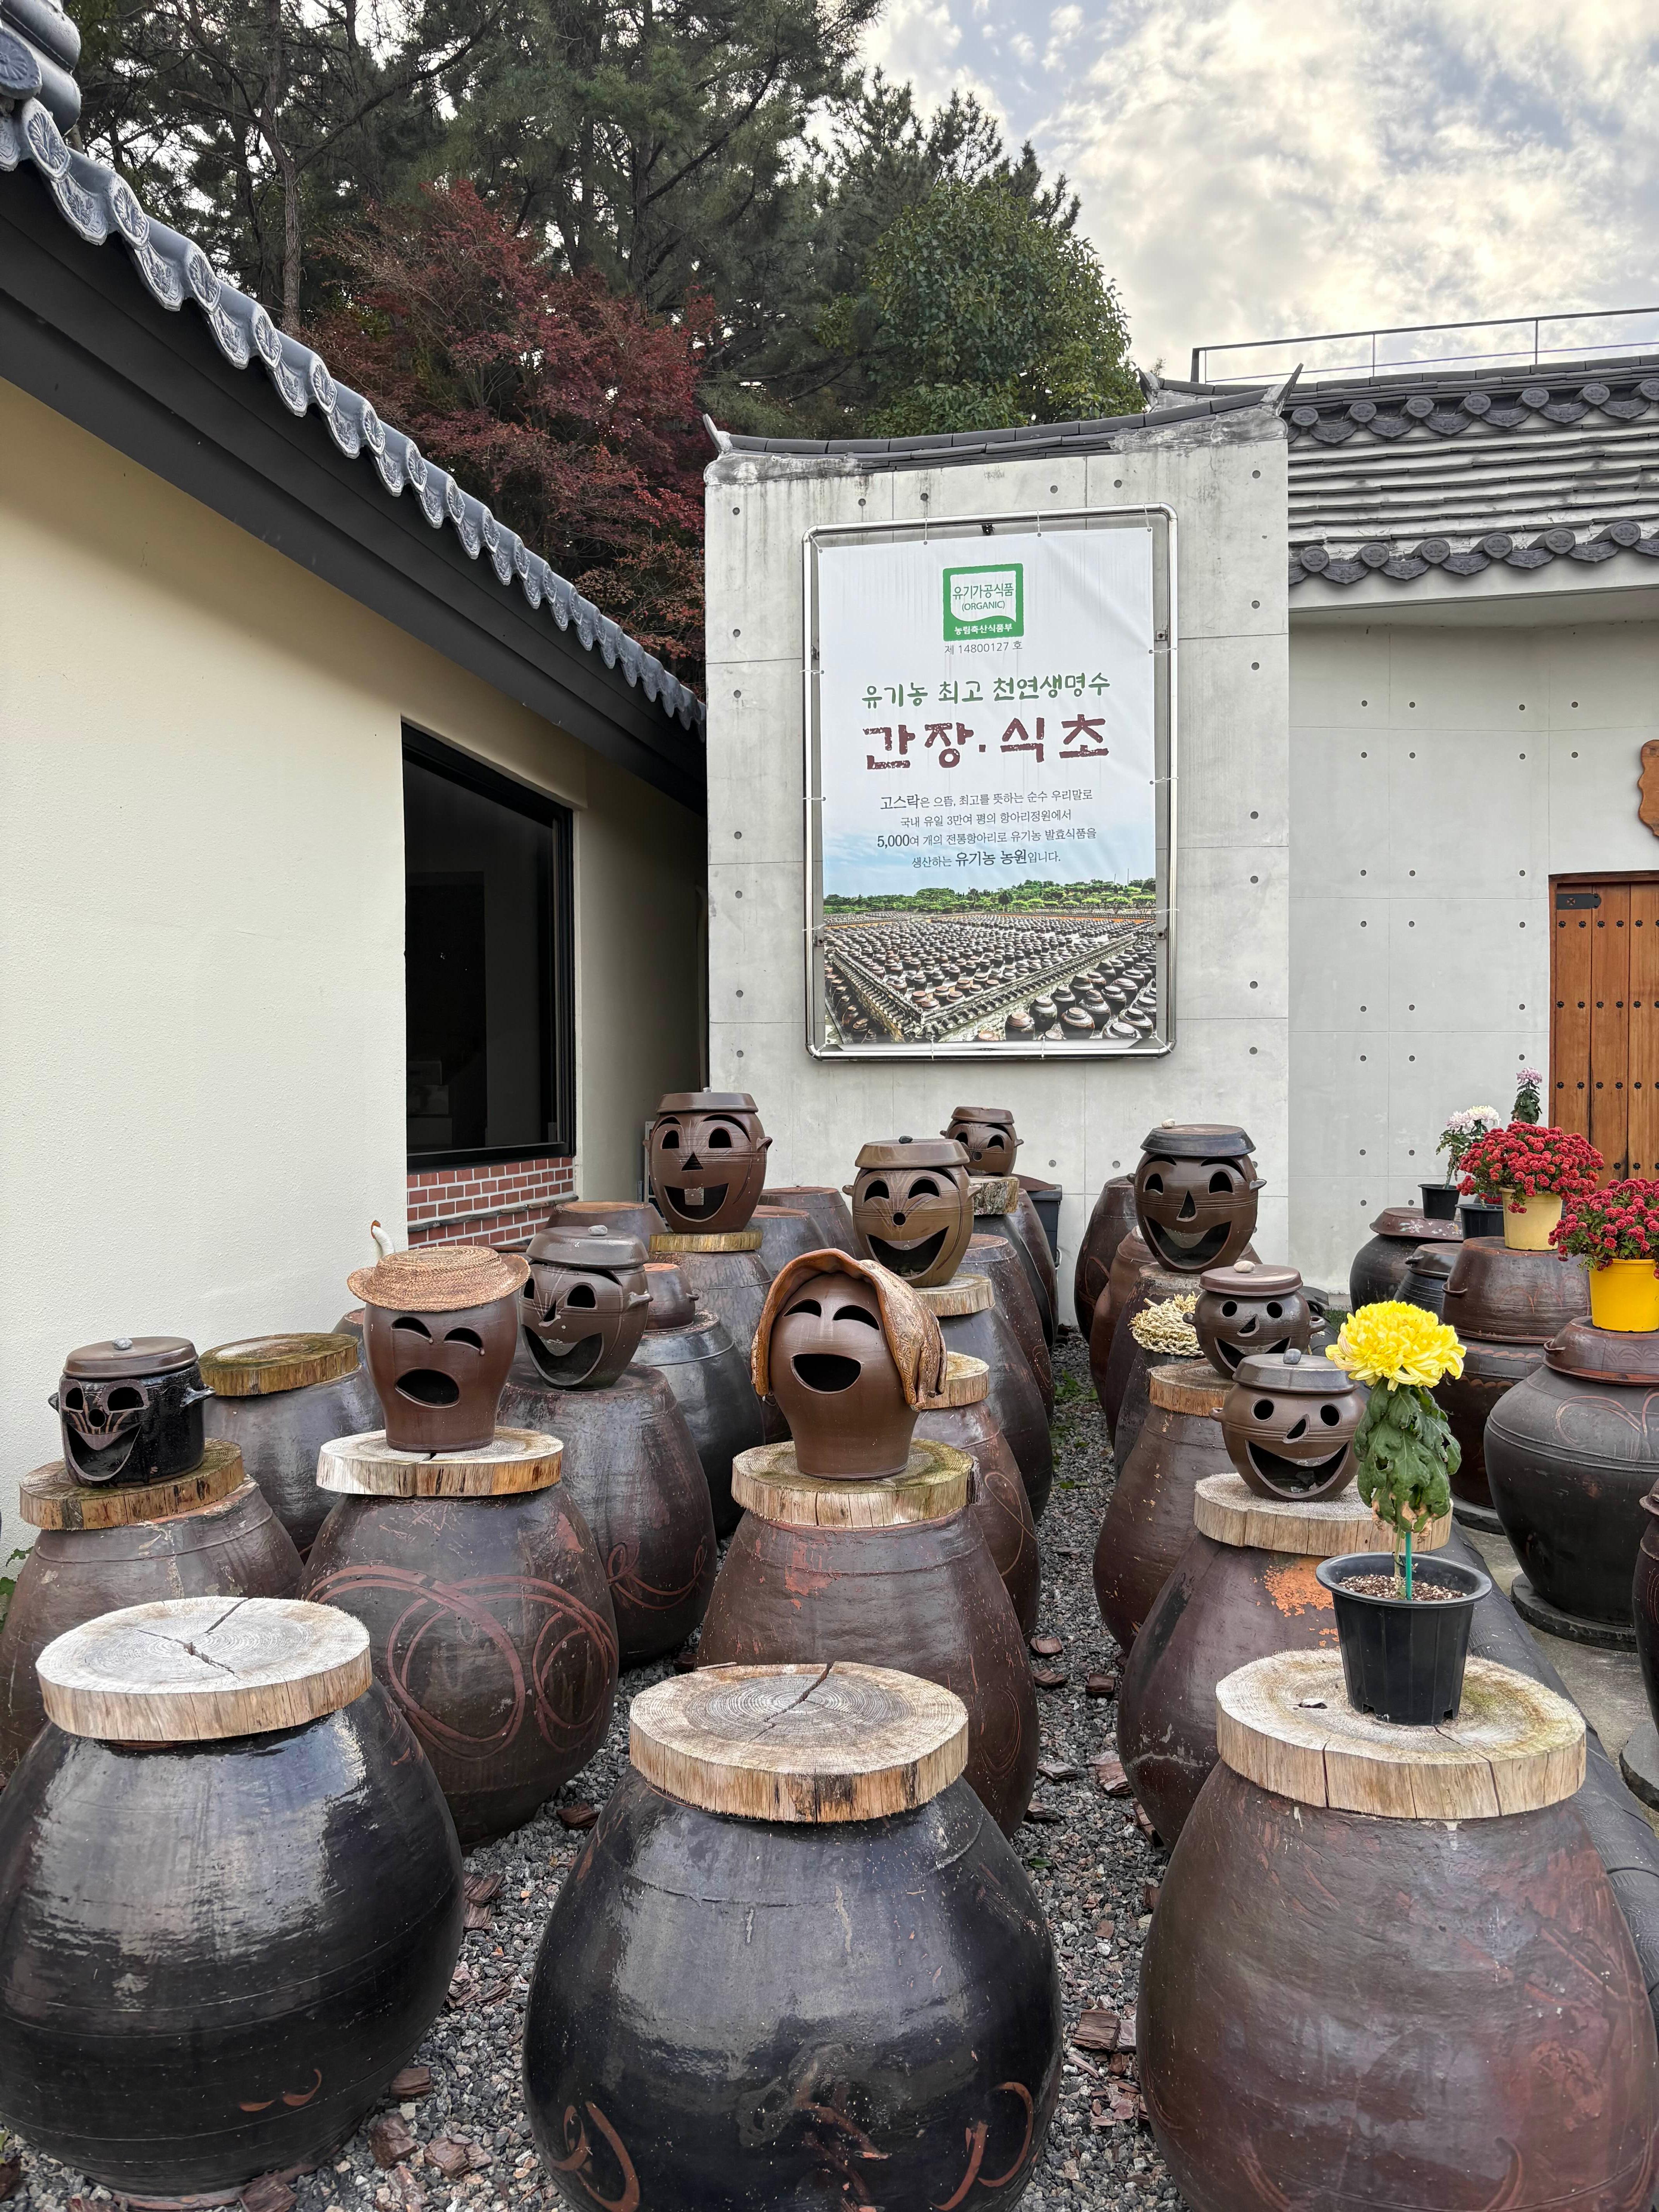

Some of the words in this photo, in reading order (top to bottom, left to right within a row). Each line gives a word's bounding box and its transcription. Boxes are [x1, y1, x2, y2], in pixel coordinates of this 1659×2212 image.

[953, 583, 1014, 600] 유기가공식품
[962, 601, 1005, 611] (ORGANIC)
[954, 623, 1013, 635] 농림축산식품부
[945, 645, 954, 655] 제
[958, 642, 1009, 654] 14800127
[1012, 641, 1022, 650] 호
[862, 682, 928, 709] 유기농
[938, 680, 983, 704] 최고
[993, 672, 1110, 702] 천연생명수
[880, 794, 930, 809] 고스락은
[933, 796, 956, 807] 으뜸,
[959, 794, 989, 805] 최고를
[993, 793, 1024, 804] 뜻하는
[1027, 791, 1048, 802] 순수
[1051, 789, 1093, 801] 우리말로
[900, 816, 919, 828] 국내
[924, 815, 943, 827] 유일
[947, 814, 972, 826] 3만여
[976, 813, 996, 824] 평의
[1000, 809, 1071, 823] 항아리정원에서
[878, 835, 919, 848] 5,000여
[923, 834, 942, 845] 개의
[946, 832, 1007, 845] 전통항아리로
[1011, 830, 1041, 842] 유기농
[1045, 828, 1097, 841] 발효식품을
[912, 856, 952, 868] 생산하는
[955, 852, 996, 867] 유기농
[1000, 849, 1061, 864] 농원입니다.
